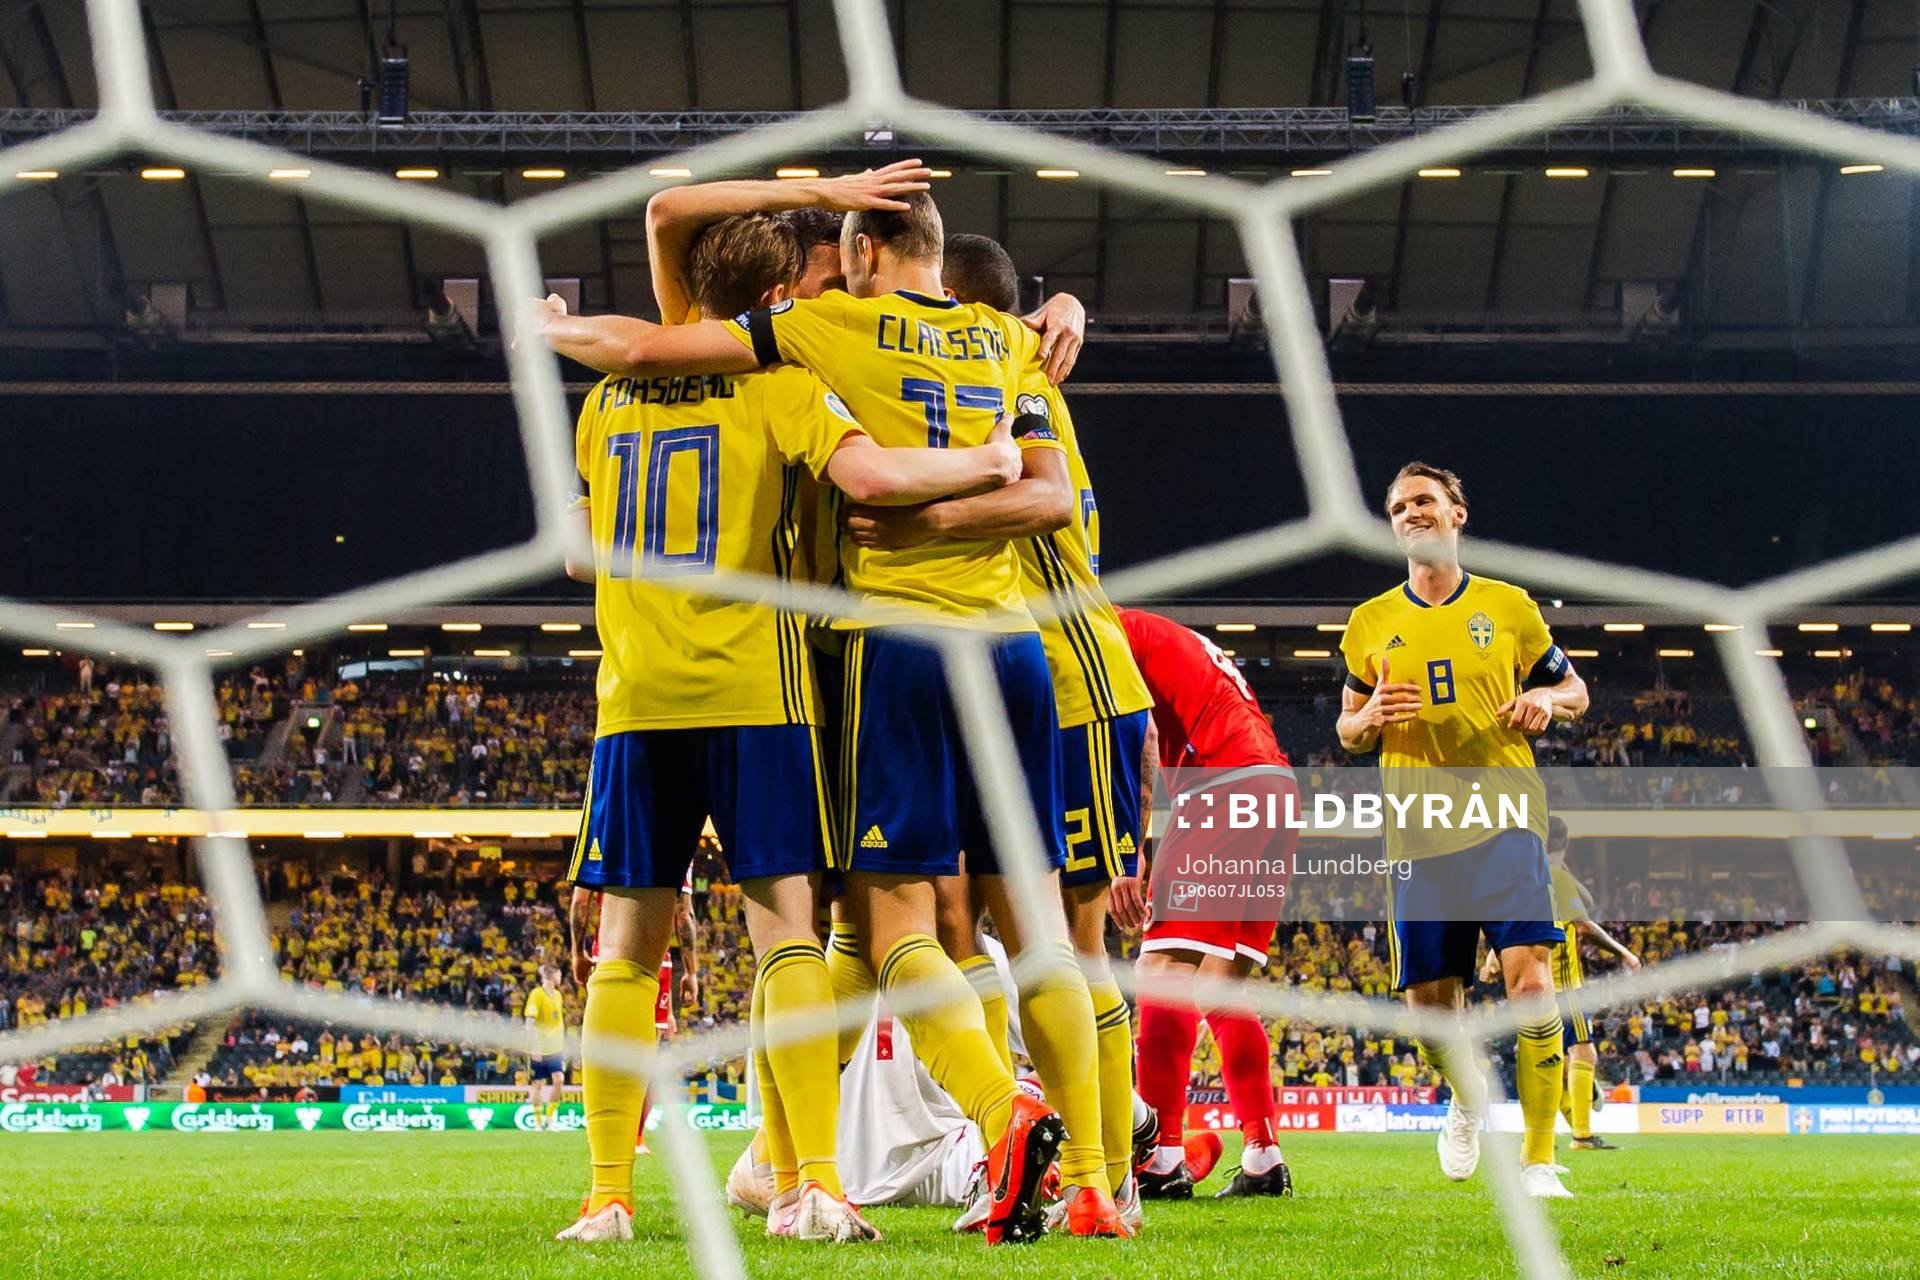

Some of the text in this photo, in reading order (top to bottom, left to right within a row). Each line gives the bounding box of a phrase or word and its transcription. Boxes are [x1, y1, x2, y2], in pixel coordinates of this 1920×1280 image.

[608, 424, 720, 577] 10
[1426, 658, 1456, 705] 8
[1065, 808, 1097, 872] 2
[0, 1103, 102, 1131] Carlsberg
[171, 1103, 273, 1131] Carlsberg
[343, 1104, 445, 1131] Carlsberg
